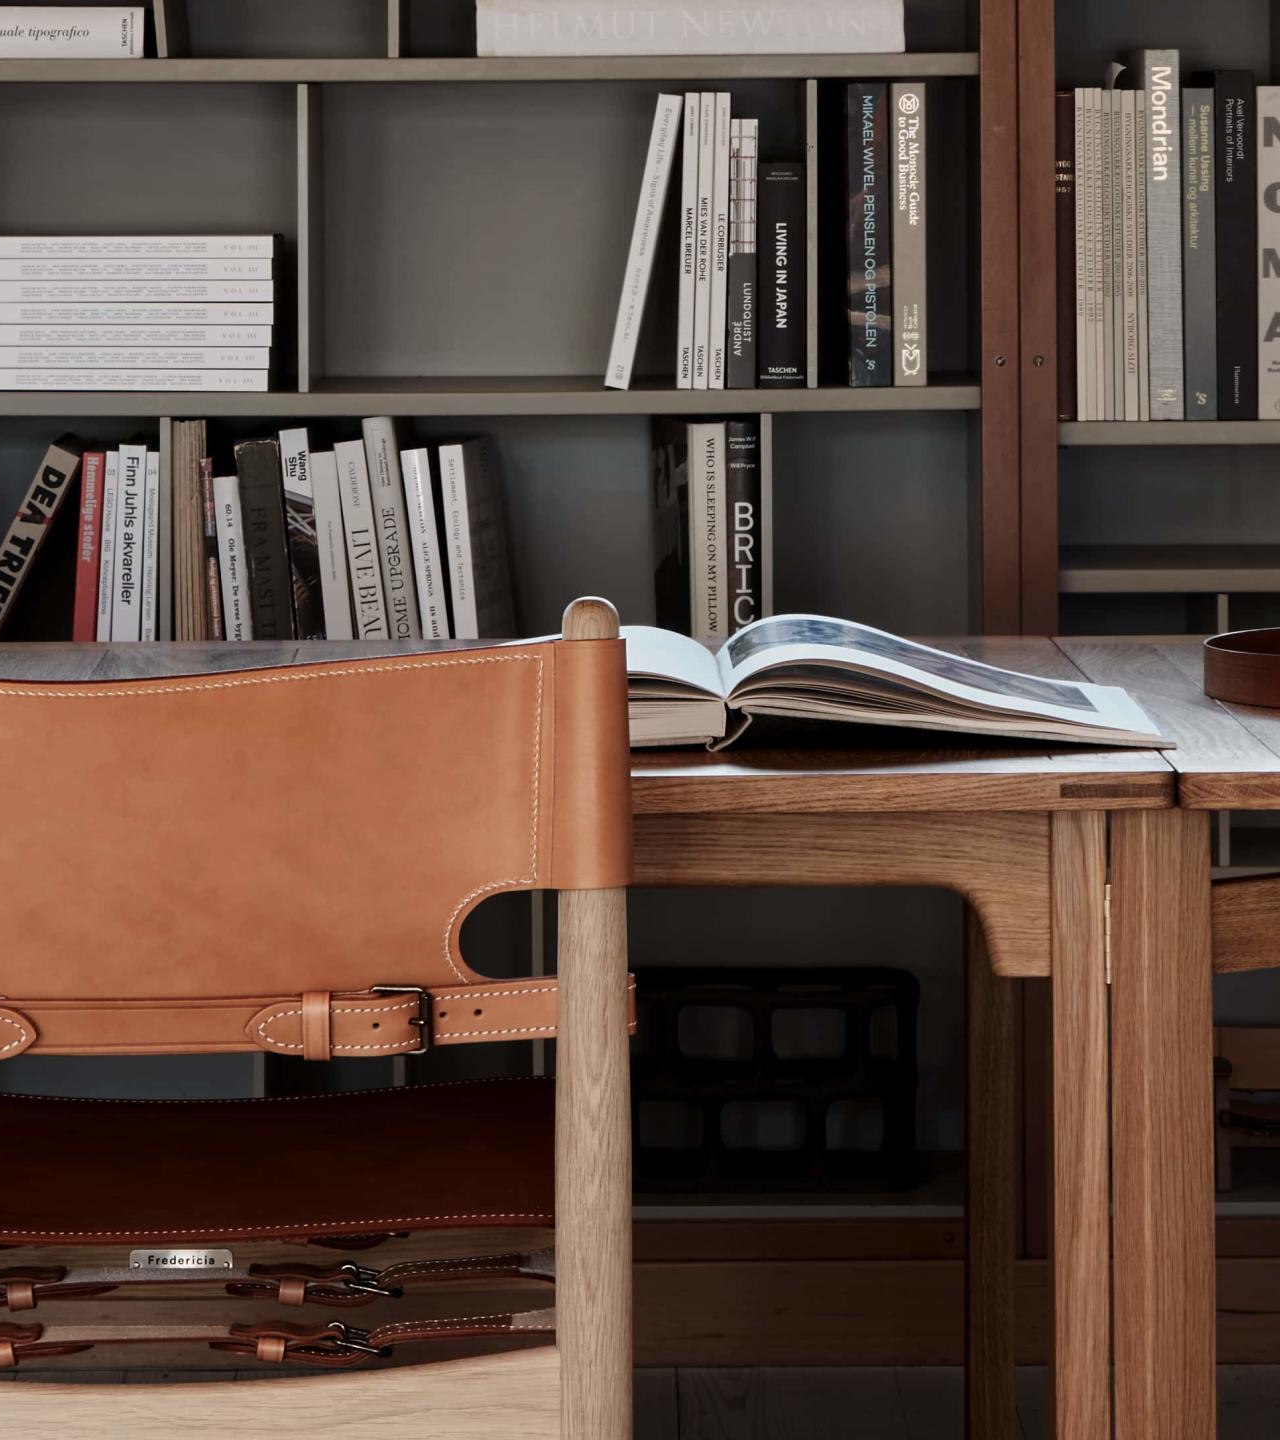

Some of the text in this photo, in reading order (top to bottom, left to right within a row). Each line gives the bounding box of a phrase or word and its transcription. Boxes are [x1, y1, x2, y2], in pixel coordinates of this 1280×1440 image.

[27, 25, 91, 41] tipografico
[494, 8, 662, 41] HELMUT
[1151, 66, 1173, 181] Mondrian
[1225, 98, 1234, 134] Portraits
[1236, 98, 1245, 160] Axel Vervoordt
[898, 116, 909, 211] to Good Business
[908, 115, 920, 226] The Monocle Guide
[1199, 104, 1210, 192] Susanne Ussing
[1187, 118, 1199, 249] mellem kunst og arkitektur
[684, 207, 693, 275] MARCEL BREUER
[698, 197, 708, 282] MIES VAN DER ROHE
[716, 213, 725, 272] LE CORBUSIER
[862, 95, 877, 348] MIKAEL WIVEL PENSLEN OG PISTOLEN
[775, 222, 788, 329] LIVING IN JAPAN
[731, 320, 742, 356] ANDRÉ
[742, 282, 752, 342] LUNDQUIST
[696, 345, 704, 377] TASCHEN
[767, 366, 798, 374] TASCHEN
[1128, 353, 1136, 374] SLOT
[288, 456, 297, 477] Shu
[297, 451, 307, 481] Wang
[349, 460, 359, 506] CALDERONE
[740, 462, 755, 470] Pryce
[19, 464, 66, 525] DEA
[81, 456, 100, 563] Hemmelige steder
[224, 503, 233, 528] 60.14
[120, 455, 140, 606] Finn Juhls akvareller
[351, 528, 375, 580] LIVE
[381, 506, 405, 592] UPGRADE
[422, 542, 430, 566] ALICE
[705, 437, 718, 632] WHO IS SLEEPING ON MY PILLOW
[228, 554, 237, 583] Meyer:
[251, 506, 274, 609] FRA MAST
[425, 565, 434, 598] SPRINGS
[233, 585, 238, 596] De
[429, 605, 436, 618] us
[147, 1255, 216, 1266] Fredericia
